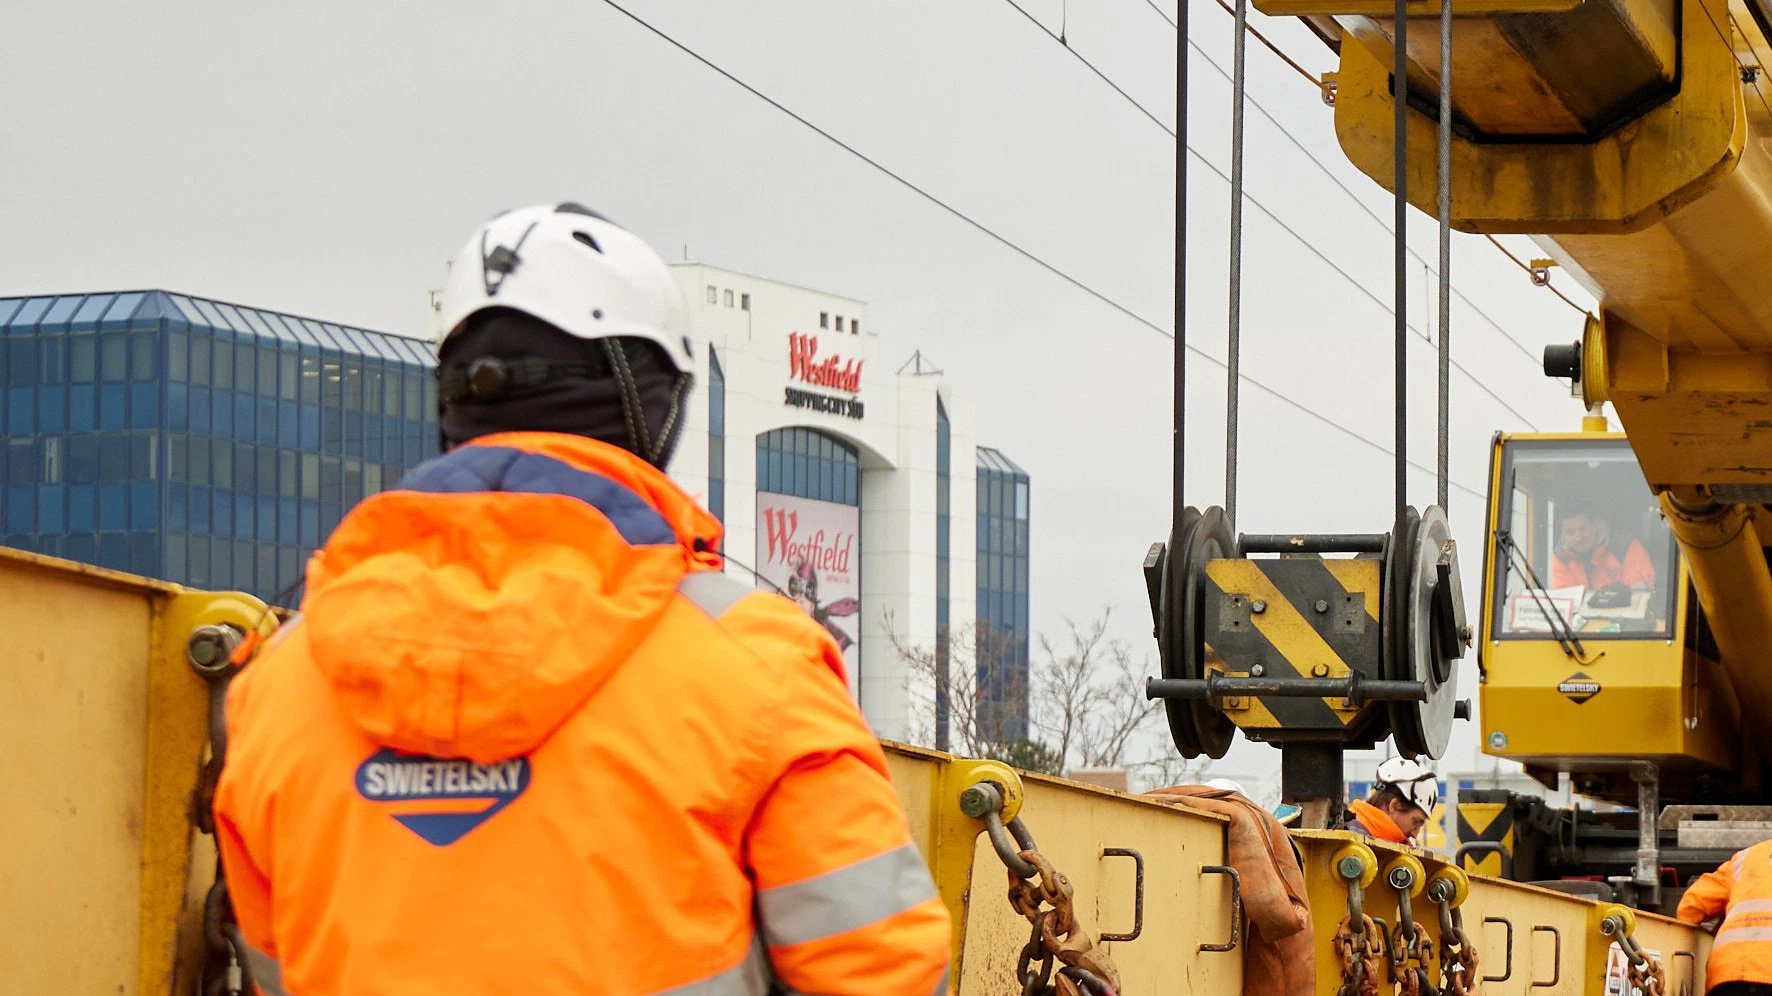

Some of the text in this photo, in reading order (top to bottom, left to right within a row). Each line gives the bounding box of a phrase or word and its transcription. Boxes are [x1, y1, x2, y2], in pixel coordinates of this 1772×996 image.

[789, 330, 863, 394] Westfield
[763, 505, 854, 574] Westfield
[365, 759, 523, 796] SWIETELSKY
